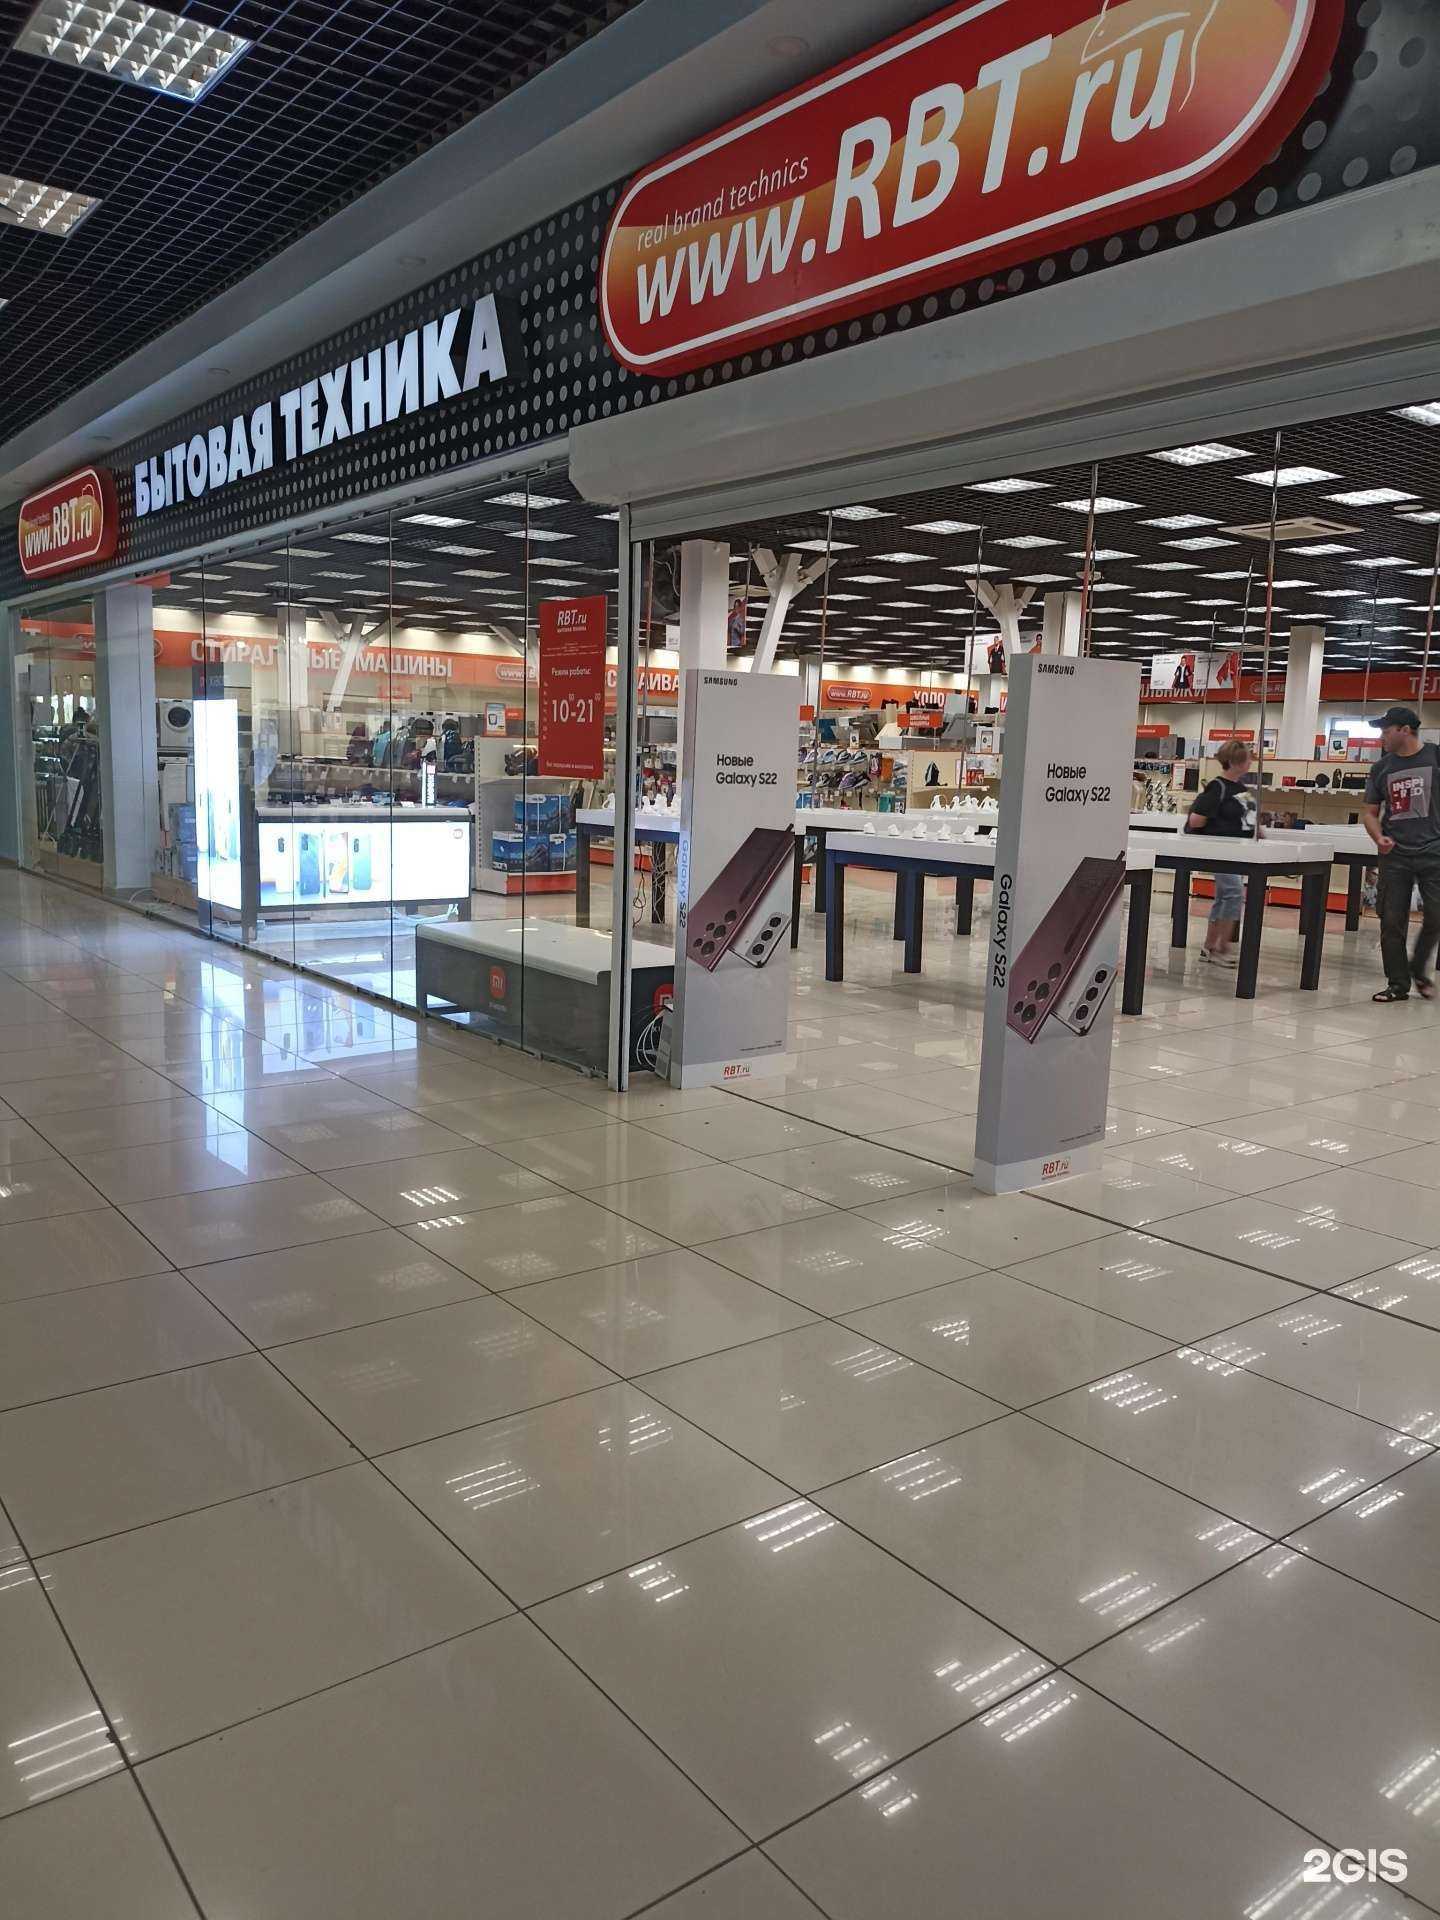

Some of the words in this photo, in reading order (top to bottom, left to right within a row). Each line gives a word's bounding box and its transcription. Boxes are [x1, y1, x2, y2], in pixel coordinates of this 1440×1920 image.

[637, 29, 1185, 325] www.RBT.ru
[638, 214, 668, 252] real
[673, 186, 724, 236] brand
[729, 156, 809, 210] technics
[135, 402, 273, 518] БЫТОВАЯ
[279, 292, 508, 462] ТЕХНИКА
[25, 497, 92, 558] www.RBT.ru
[557, 609, 587, 626] RBT.ru
[191, 639, 341, 670] СТИРАЛЫЕ
[355, 652, 453, 677] МАШИНЫ
[1037, 663, 1075, 676] SAMSUNG
[703, 676, 738, 687] SAMSUNG
[716, 753, 754, 767] Новые
[1047, 763, 1087, 780] Новые
[716, 771, 757, 788] Galaxy
[759, 772, 778, 785] S22
[1045, 786, 1089, 806] Galaxy
[1090, 786, 1111, 802] S22
[678, 839, 689, 898] Galaxy
[993, 874, 1012, 950] Galaxy
[993, 953, 1007, 988] S22
